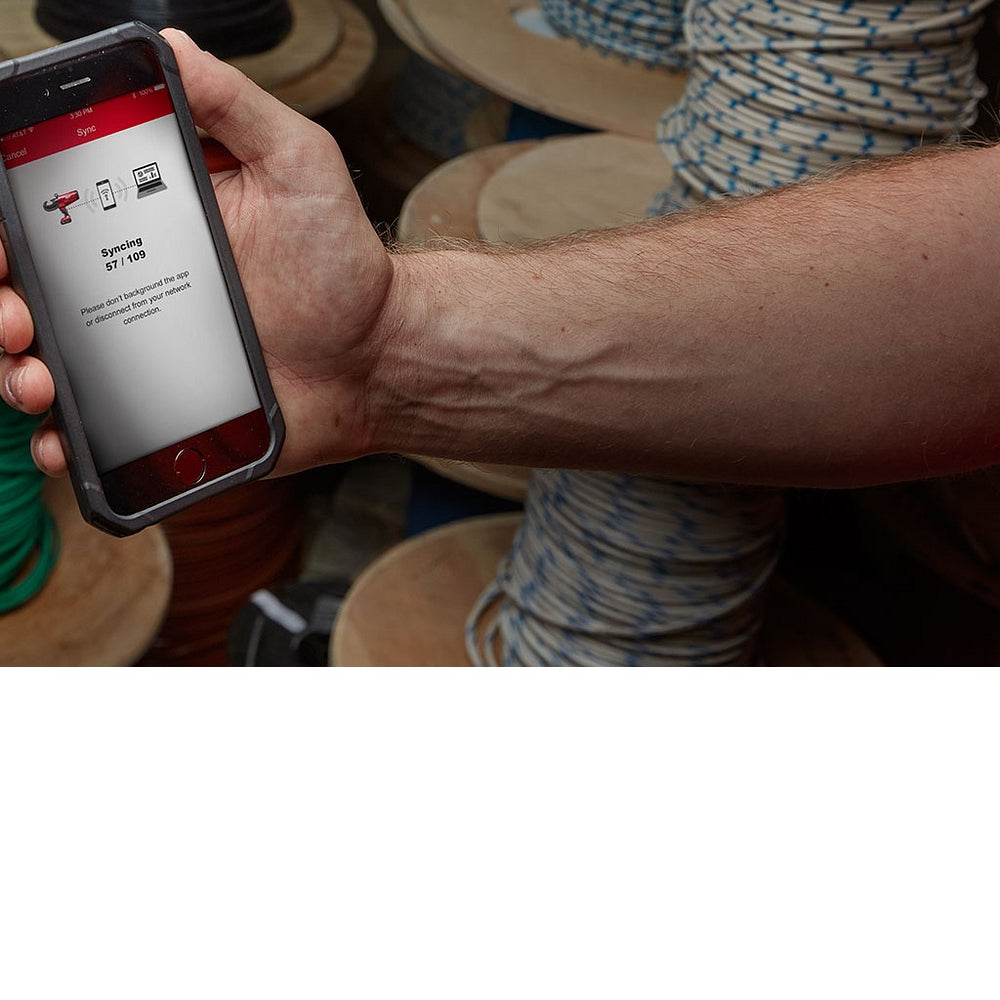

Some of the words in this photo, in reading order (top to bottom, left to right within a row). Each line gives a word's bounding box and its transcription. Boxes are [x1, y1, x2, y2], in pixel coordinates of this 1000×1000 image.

[76, 125, 97, 137] Sync
[101, 237, 143, 258] Syncing
[105, 260, 118, 272] 57
[126, 250, 146, 263] 109
[80, 302, 105, 316] Please
[105, 294, 123, 307] don't
[123, 279, 164, 300] background
[164, 275, 176, 285] the
[176, 270, 190, 281] app
[85, 319, 94, 327] or
[94, 304, 132, 324] disconnect
[132, 298, 149, 310] from
[148, 292, 164, 305] your
[164, 281, 192, 298] network
[123, 306, 161, 325] connection.
